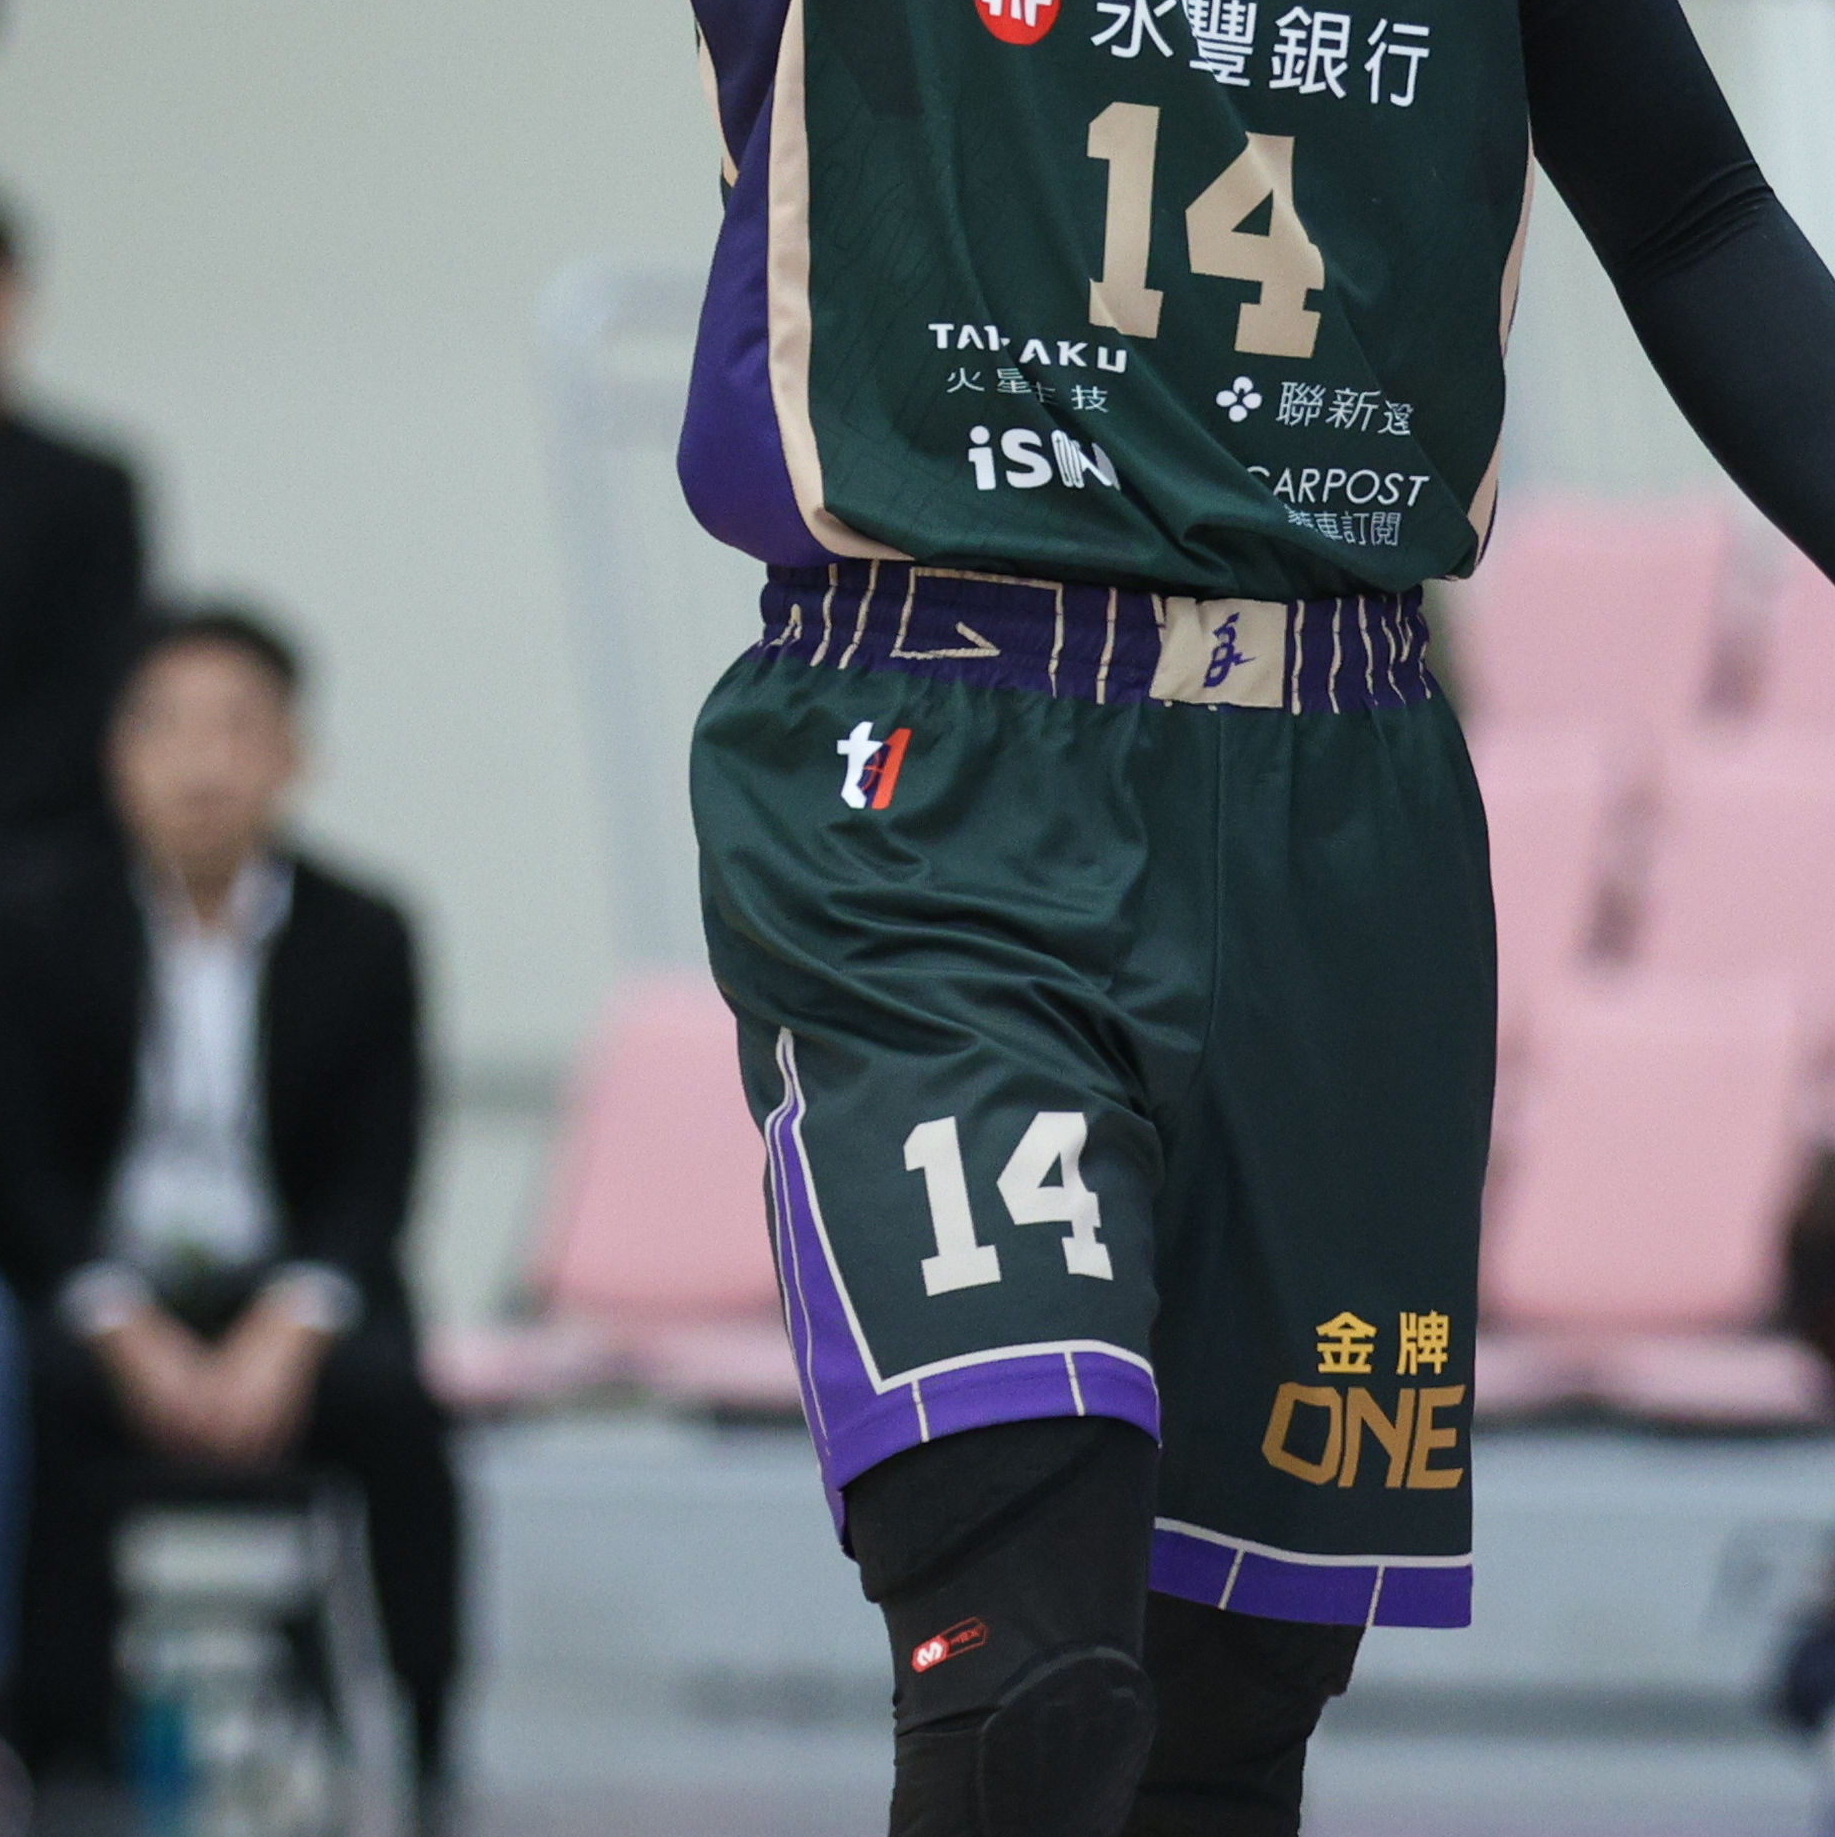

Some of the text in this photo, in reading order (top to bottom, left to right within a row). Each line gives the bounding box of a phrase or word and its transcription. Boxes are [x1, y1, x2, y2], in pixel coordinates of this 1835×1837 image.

[1087, 102, 1325, 359] 14
[1247, 466, 1430, 507] ARPOST
[903, 1111, 1113, 1296] 14
[1316, 1310, 1449, 1376] 金牌
[1261, 1381, 1466, 1490] ONE
